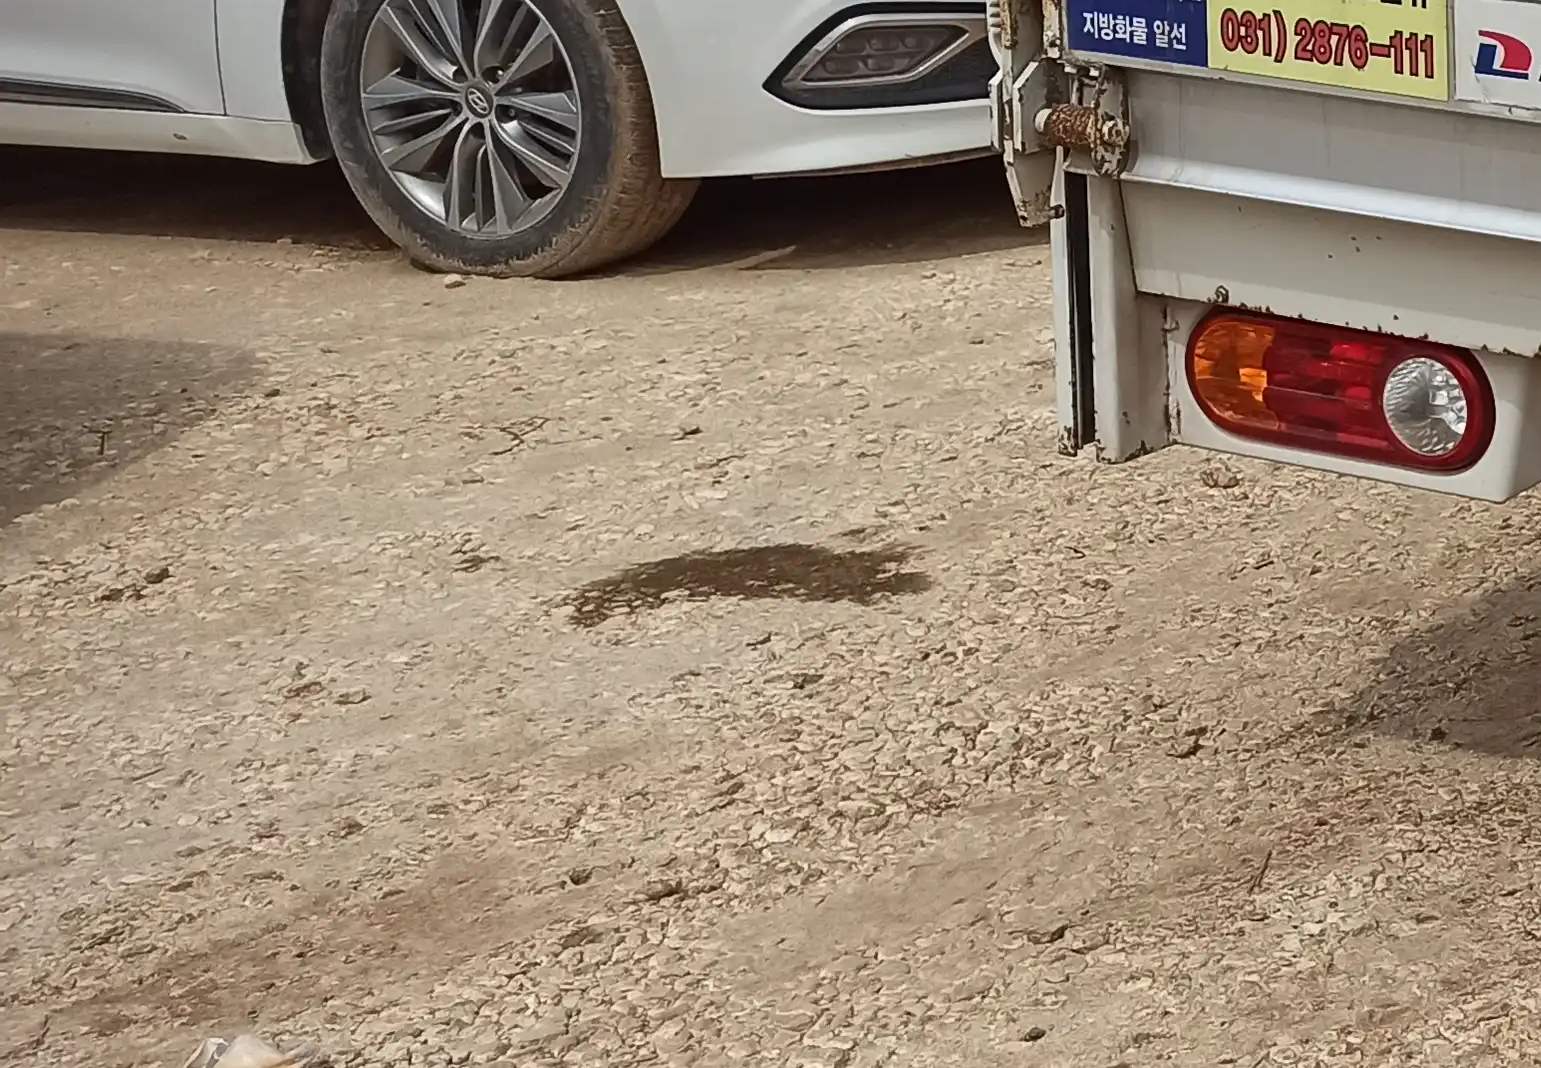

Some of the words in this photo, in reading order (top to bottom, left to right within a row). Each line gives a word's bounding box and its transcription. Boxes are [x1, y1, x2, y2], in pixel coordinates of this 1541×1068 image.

[1083, 11, 1149, 46] 지방화물
[1153, 18, 1187, 51] 알선
[1220, 8, 1287, 63] 031)
[1294, 17, 1435, 79] 2876-111
